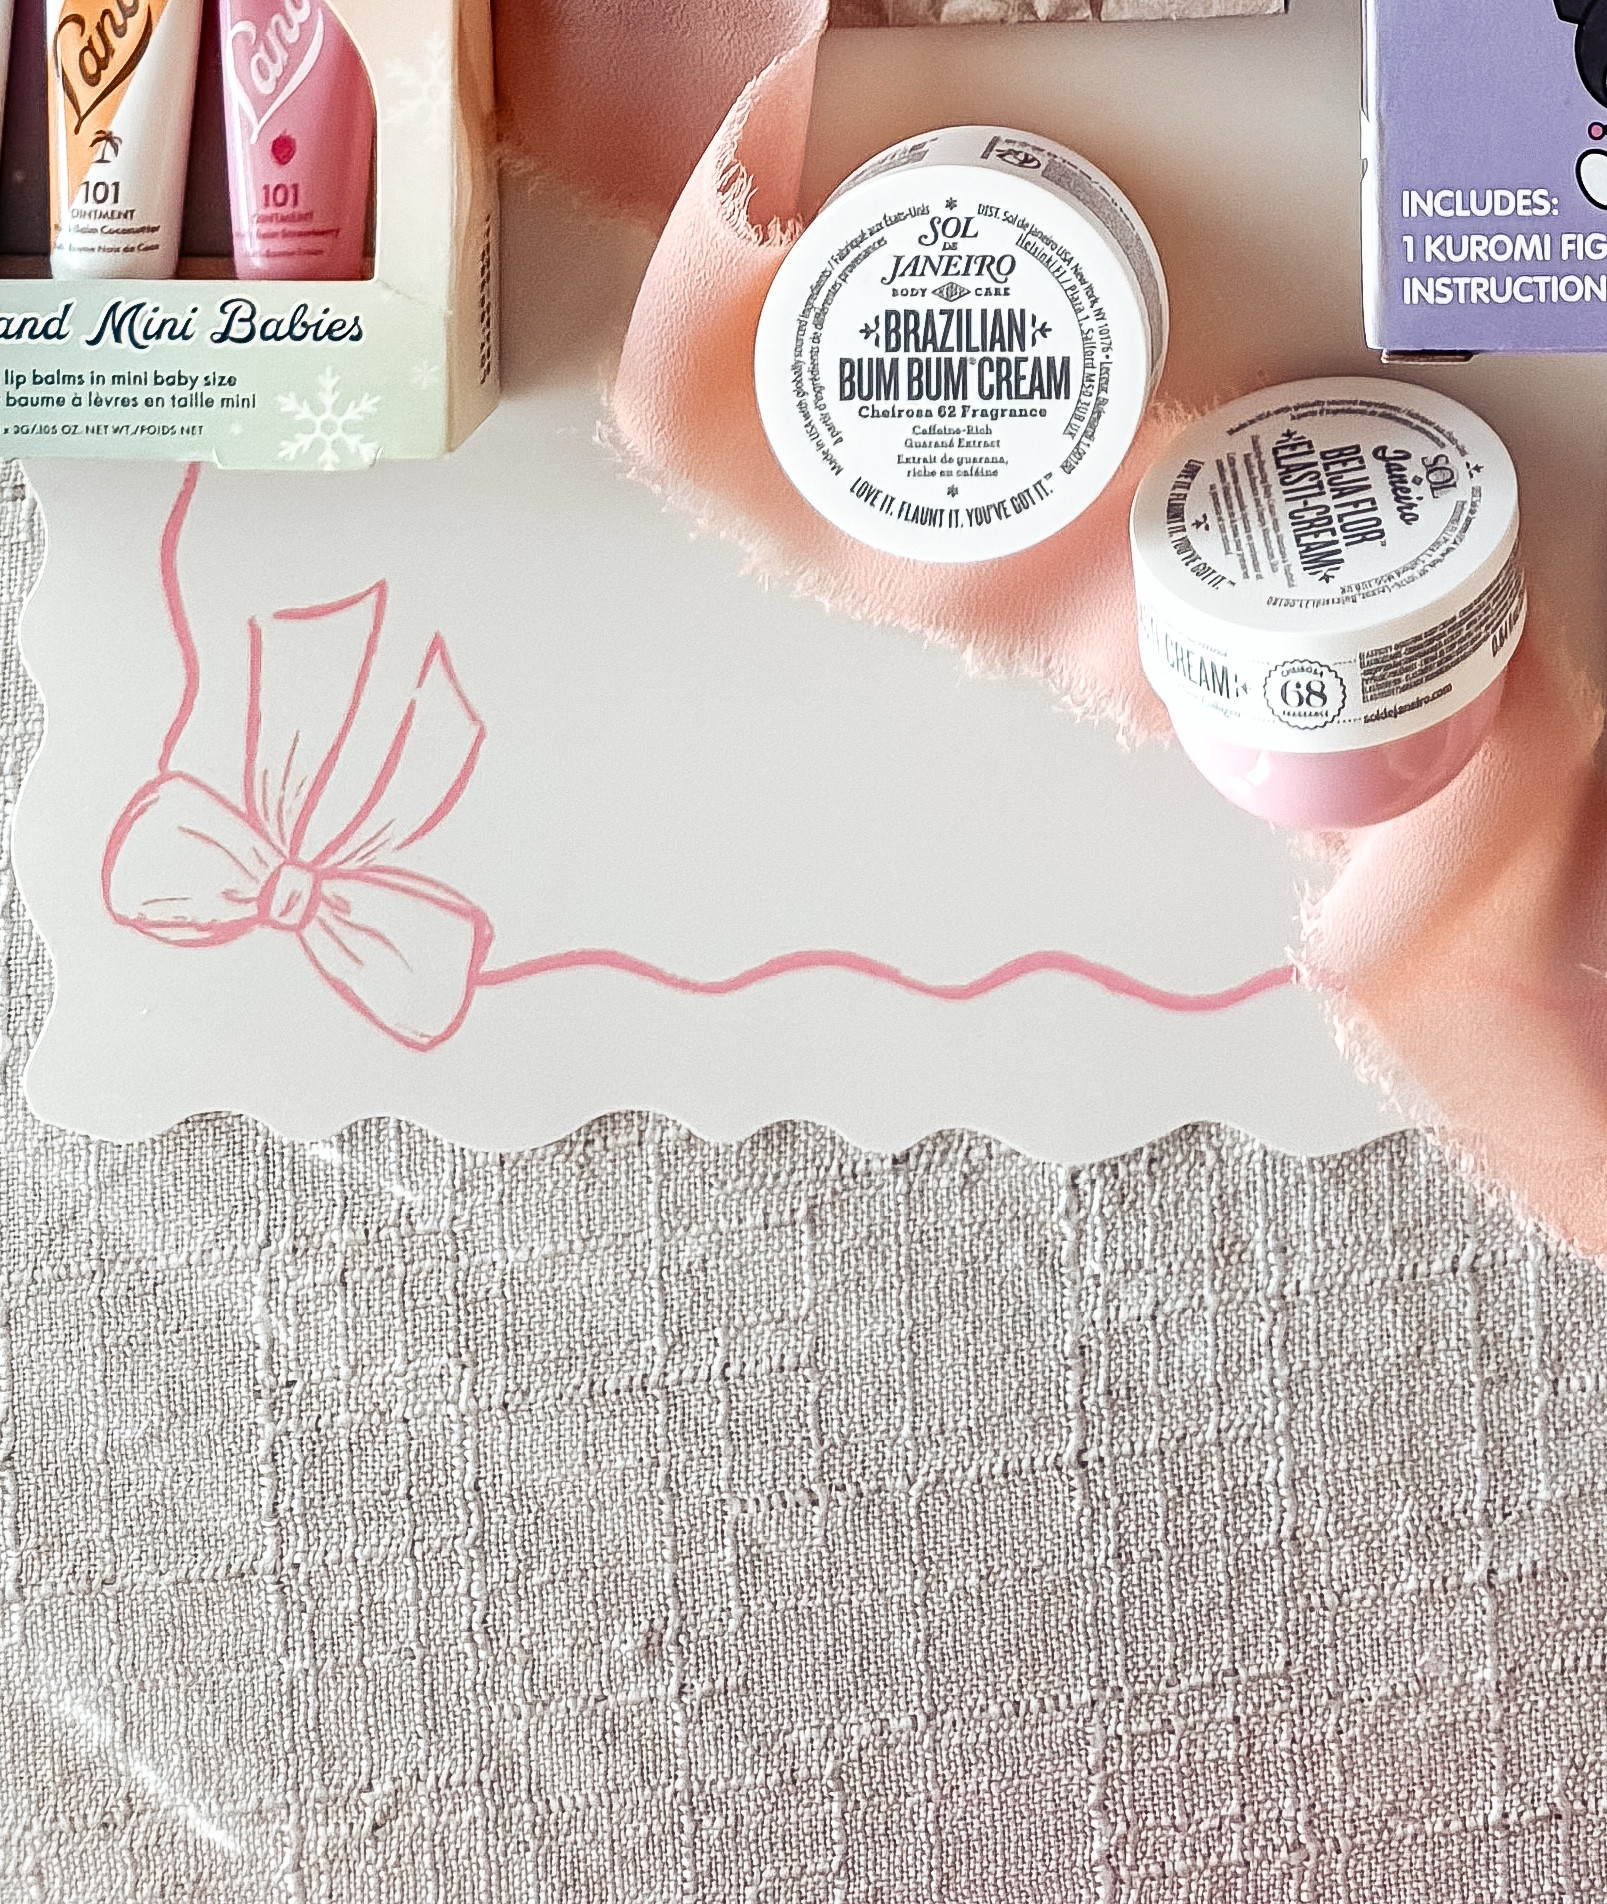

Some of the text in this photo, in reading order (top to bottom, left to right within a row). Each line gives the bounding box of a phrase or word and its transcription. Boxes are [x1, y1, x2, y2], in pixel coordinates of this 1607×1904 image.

[81, 180, 121, 205] 101
[262, 182, 300, 208] 101
[1402, 188, 1560, 218] INCLUDES:
[977, 203, 1001, 219] DIST.
[918, 216, 979, 246] SOL
[942, 241, 959, 252] DE
[1055, 245, 1075, 267] USA
[1403, 234, 1414, 263] 1
[1424, 233, 1551, 263] KUROMI
[880, 254, 1017, 286] JANEIRO
[891, 287, 928, 297] BODY
[974, 287, 1011, 297] CARE
[1065, 283, 1085, 314] Plaza
[85, 300, 199, 350] Mini
[210, 297, 364, 344] Babies
[1092, 307, 1107, 322] NY
[884, 308, 1027, 354] BRAZILIAN
[1097, 323, 1113, 353] 10176
[4, 369, 237, 390] lip balms in mini baby size
[839, 356, 899, 402] BUM
[977, 355, 1071, 401] CREAM
[5, 391, 258, 409] baume à lèvres en taille mini
[858, 404, 1048, 421] Cheirosa 62 Fragrance
[85, 424, 108, 436] NET
[180, 424, 204, 436] NET
[912, 424, 993, 435] Caffeine-Rich
[957, 438, 1001, 449] Extract
[1371, 444, 1424, 526] Janeiro
[1421, 453, 1458, 499] SOL
[850, 476, 884, 508] LOVE
[879, 493, 897, 516] IT.
[897, 500, 945, 529] FLAUNT
[966, 498, 1012, 528] YOU'VE
[1009, 487, 1037, 515] GOT
[1271, 439, 1346, 572] ELASTI-CREAM
[1319, 443, 1386, 547] BEIJA FLOR
[1165, 632, 1230, 699] CREAM
[1280, 679, 1328, 708] 68
